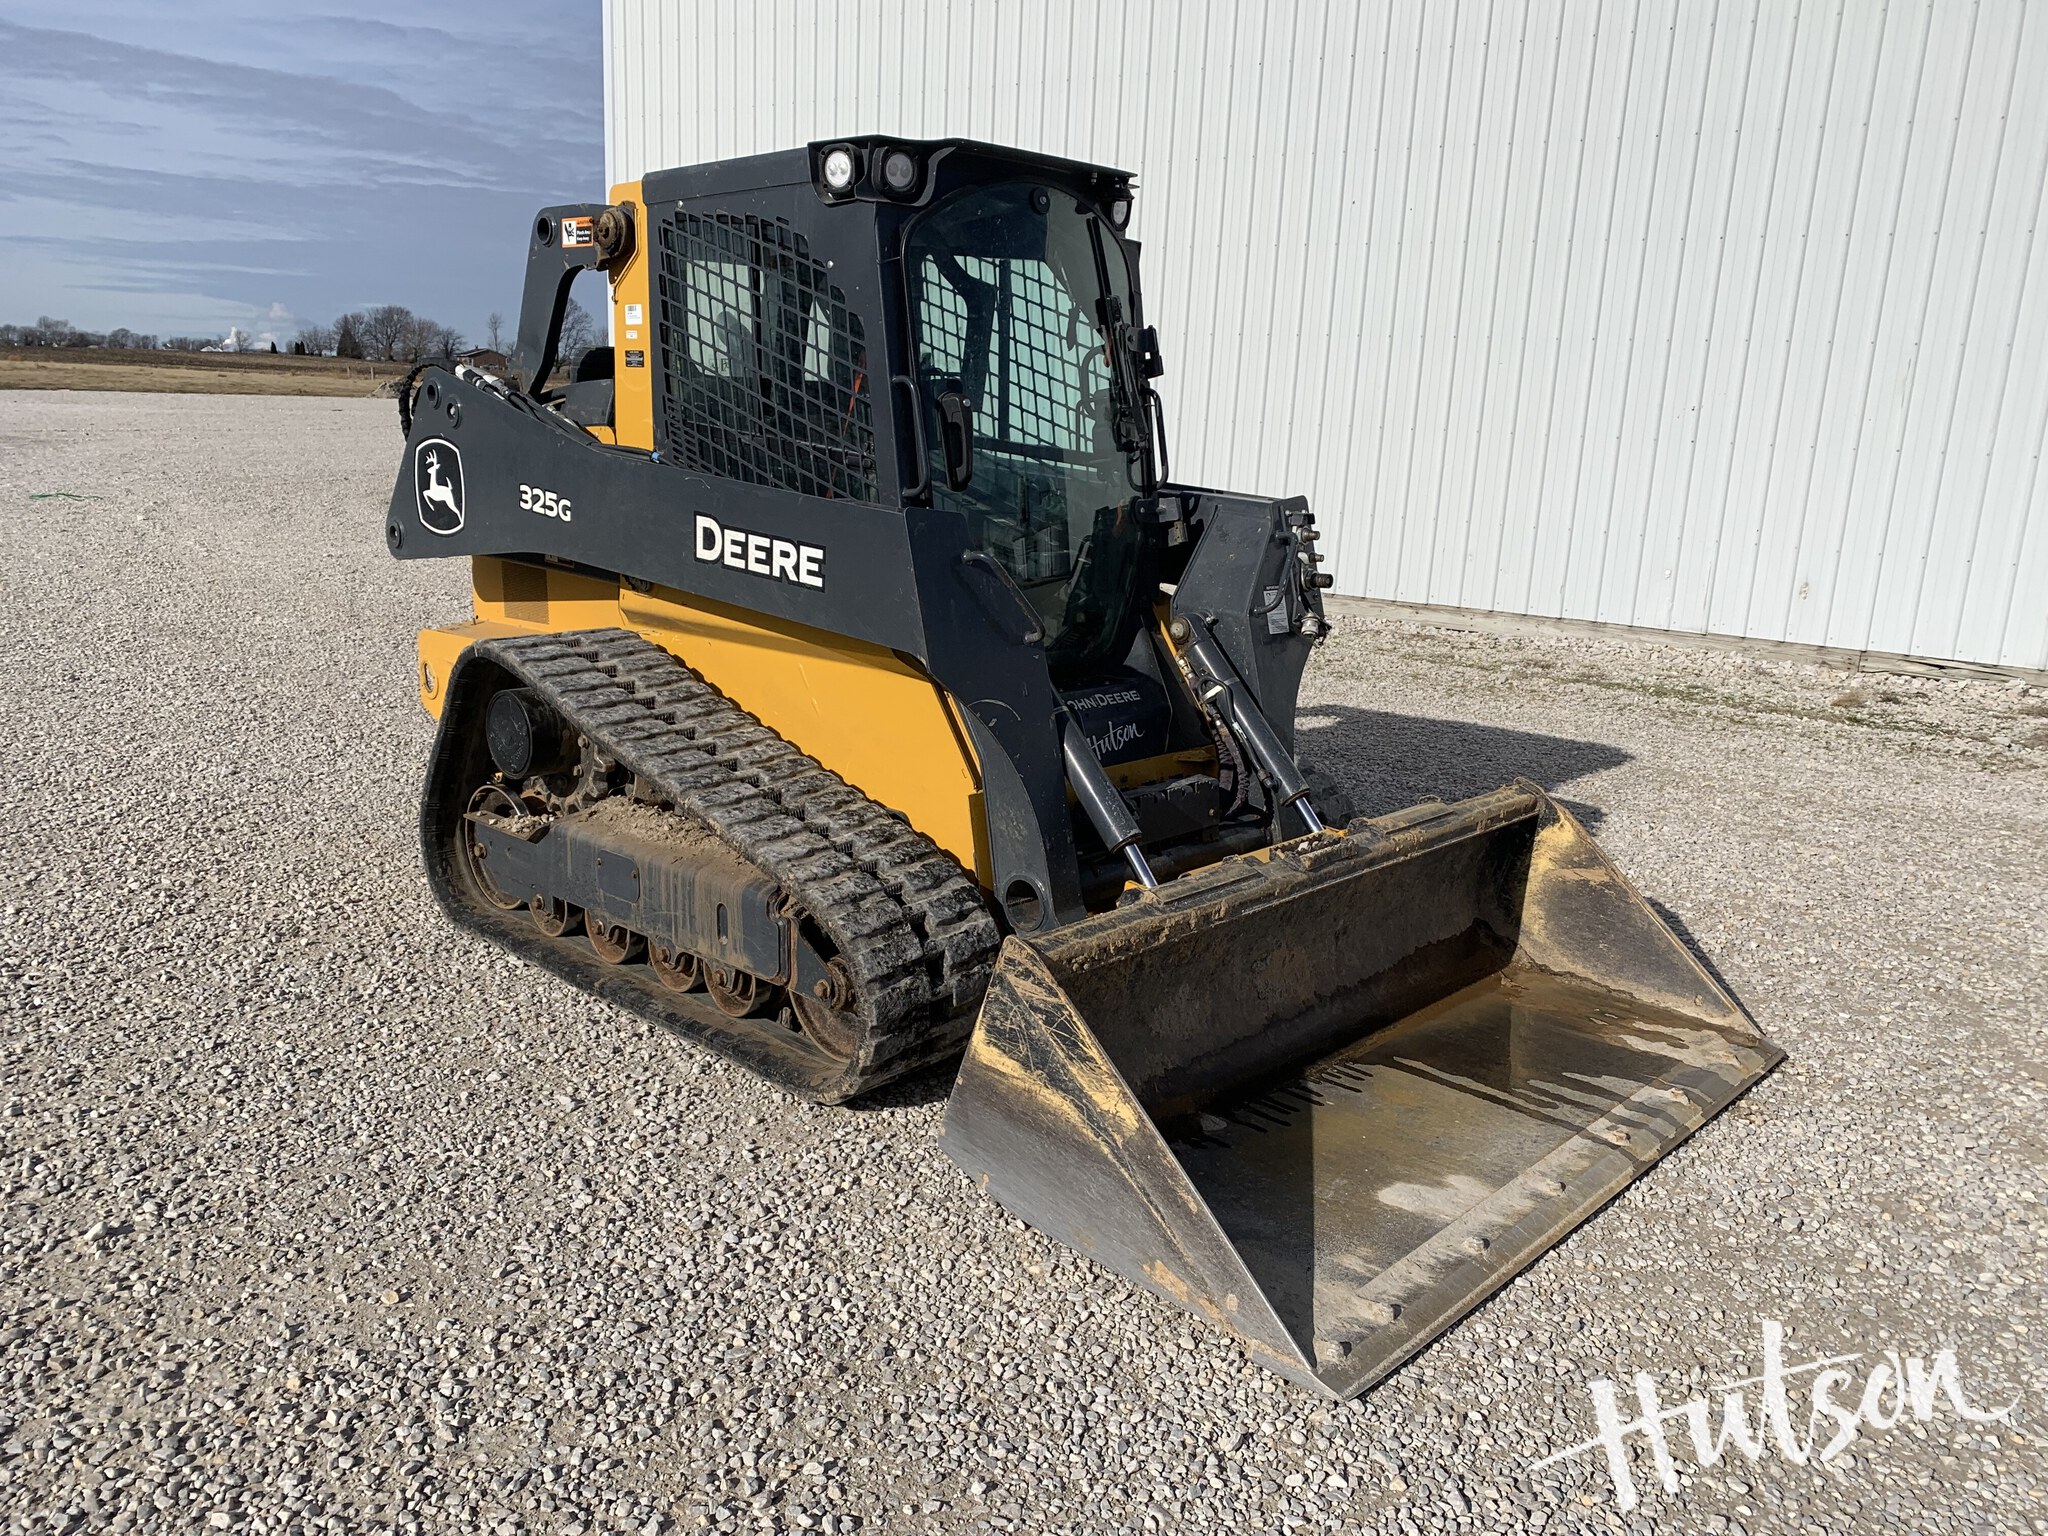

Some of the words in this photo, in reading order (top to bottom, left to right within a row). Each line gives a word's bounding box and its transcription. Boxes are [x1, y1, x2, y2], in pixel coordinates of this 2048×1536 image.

[519, 484, 571, 522] 325G
[695, 514, 824, 588] DEERE
[1066, 696, 1096, 711] OHN
[1096, 690, 1141, 708] DEERE
[1087, 720, 1146, 761] Hutson
